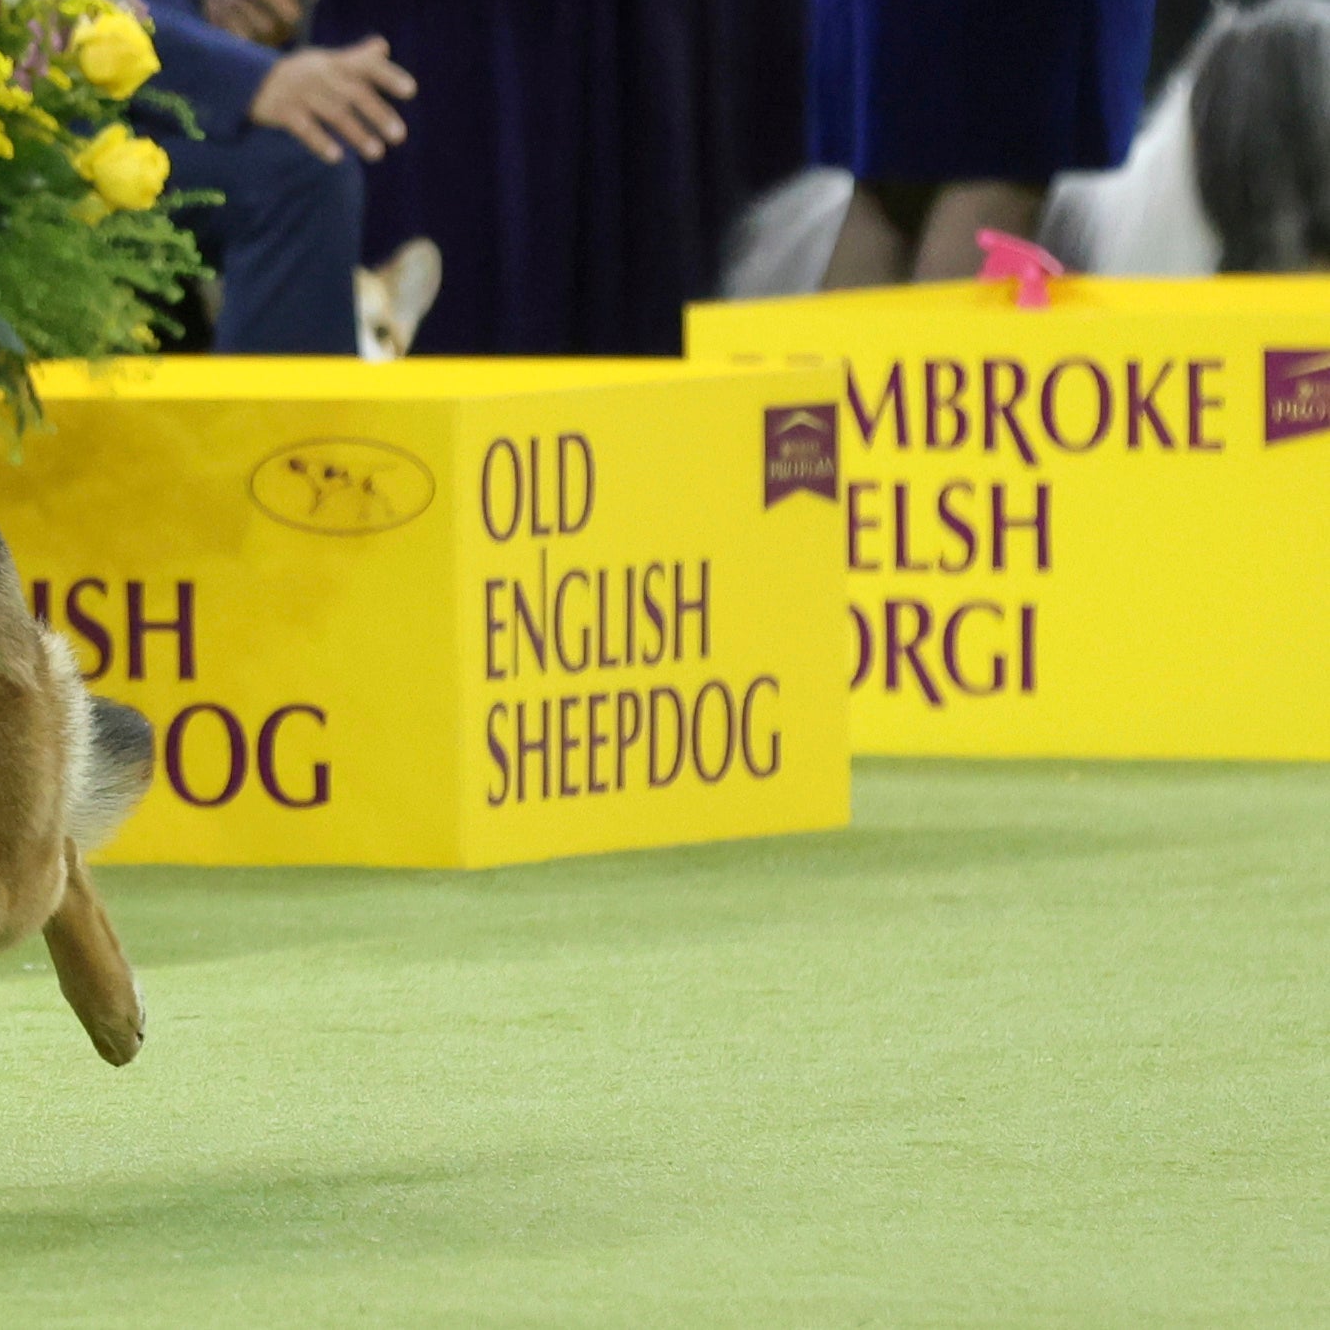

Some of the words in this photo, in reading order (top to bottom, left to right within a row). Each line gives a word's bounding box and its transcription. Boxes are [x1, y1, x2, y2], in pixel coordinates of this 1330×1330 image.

[481, 431, 595, 544] OLD
[485, 547, 710, 682] ENGLISH
[486, 672, 783, 807] SHEEPDOG
